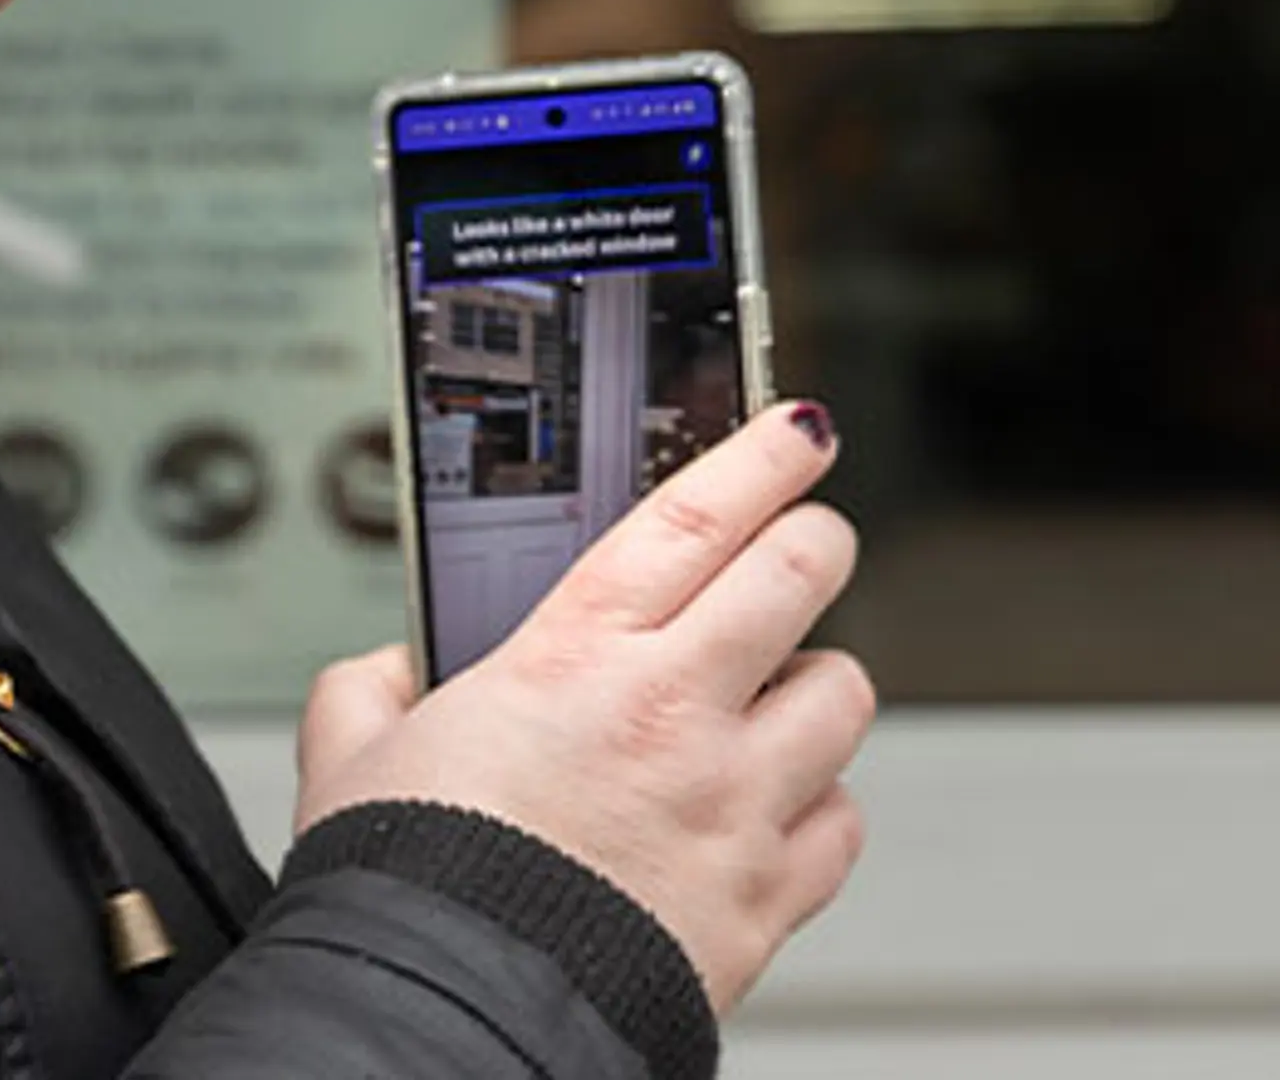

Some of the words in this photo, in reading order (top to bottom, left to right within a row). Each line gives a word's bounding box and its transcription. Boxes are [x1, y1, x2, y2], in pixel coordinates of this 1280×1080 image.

[453, 220, 509, 243] Looks
[513, 217, 548, 234] like
[553, 218, 565, 230] a
[571, 208, 625, 232] white
[629, 205, 674, 228] door
[453, 245, 499, 266] with
[503, 247, 514, 264] a
[520, 237, 596, 263] cracked
[599, 232, 676, 255] window
